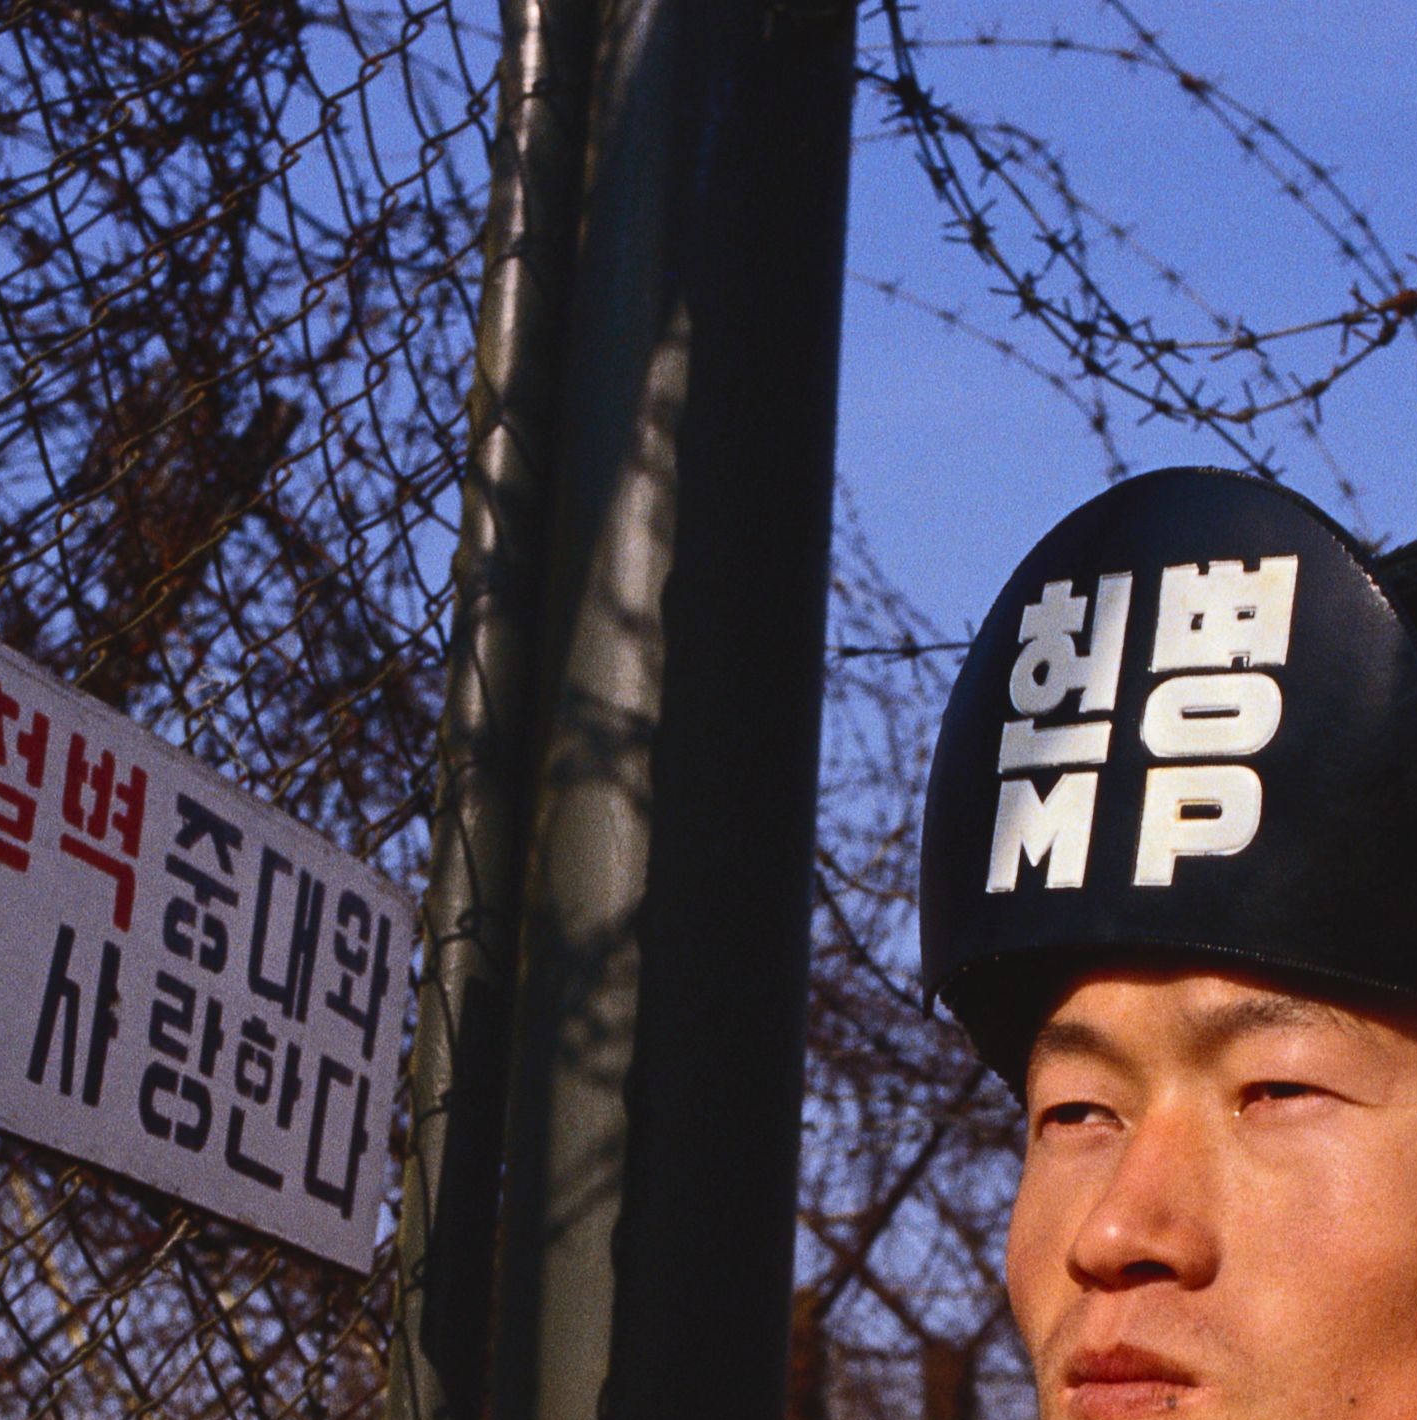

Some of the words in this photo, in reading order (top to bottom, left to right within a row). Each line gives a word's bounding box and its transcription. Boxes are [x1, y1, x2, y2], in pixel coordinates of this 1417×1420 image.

[997, 554, 1299, 775] 헌병
[985, 765, 1263, 893] MP
[27, 925, 371, 1219] 사랑한다
